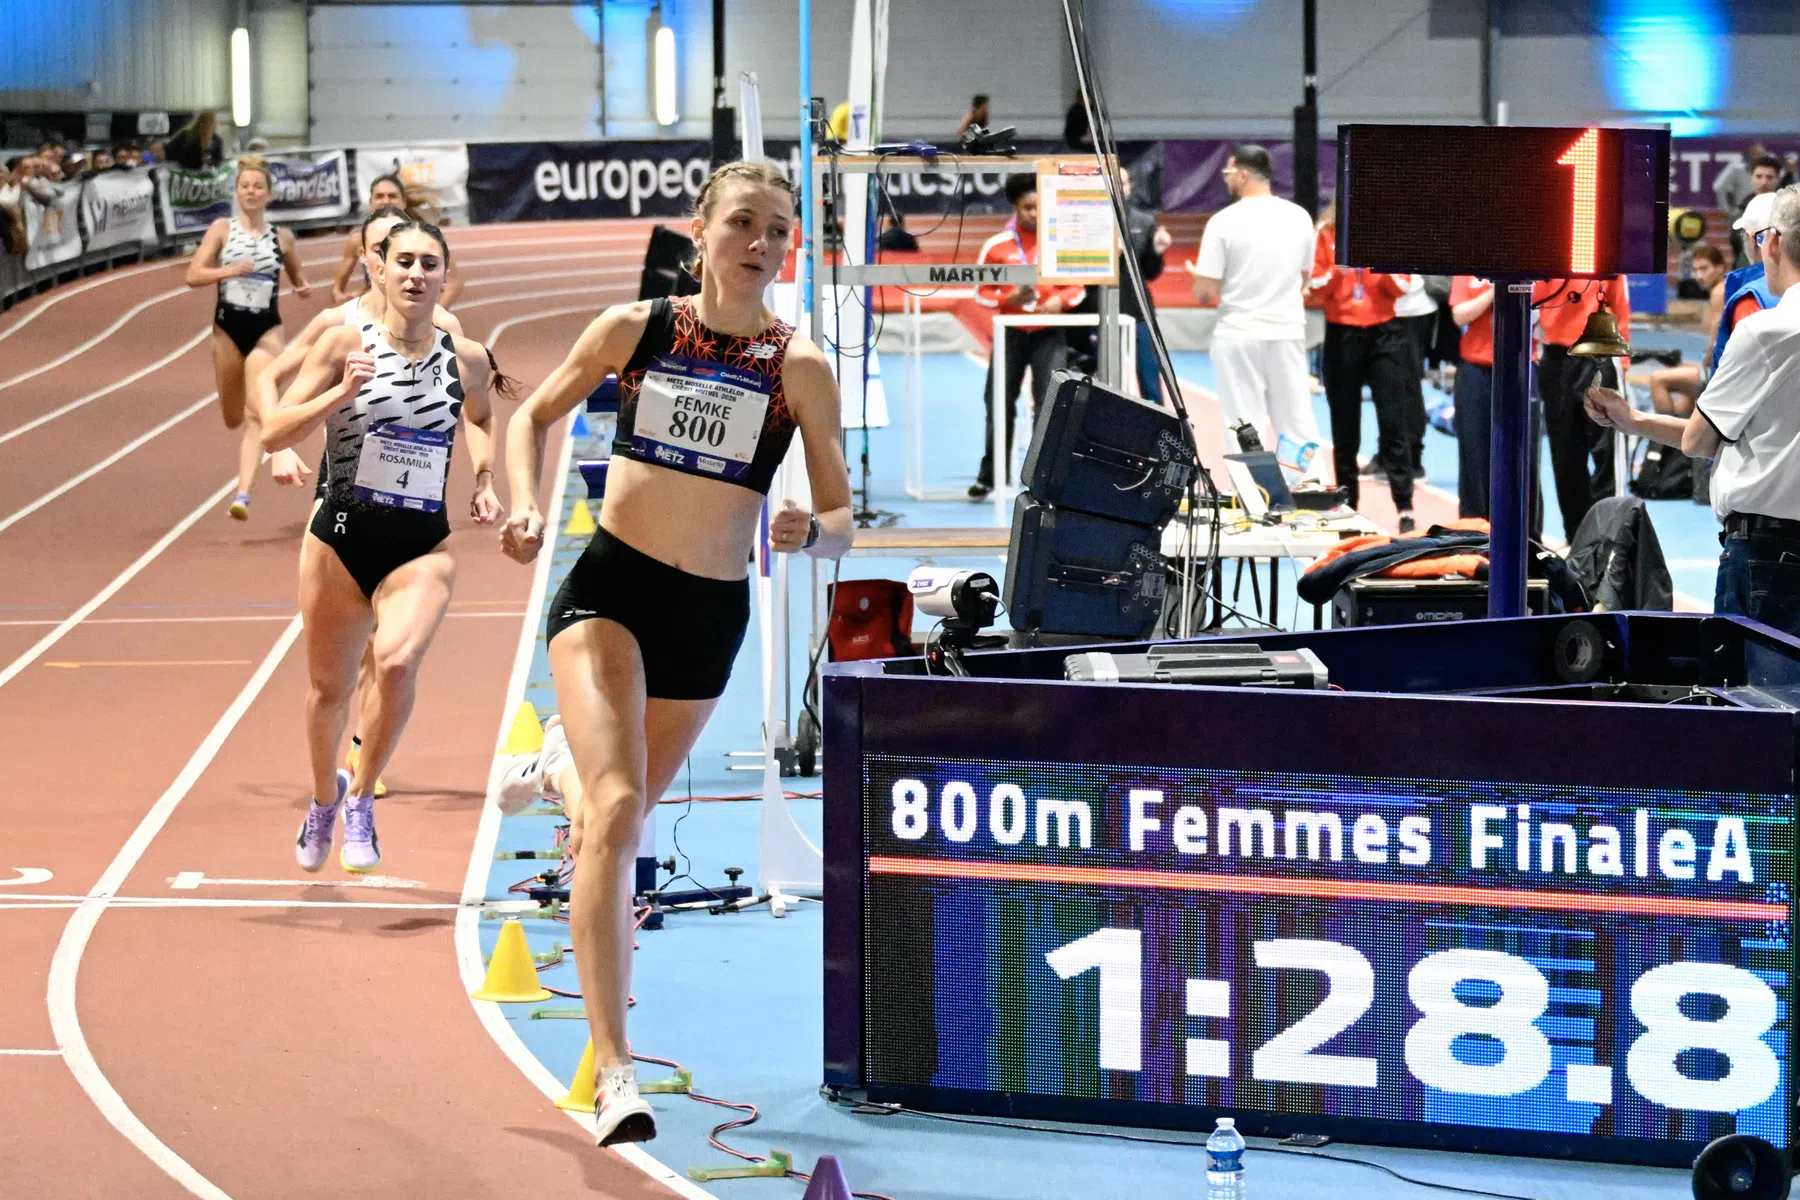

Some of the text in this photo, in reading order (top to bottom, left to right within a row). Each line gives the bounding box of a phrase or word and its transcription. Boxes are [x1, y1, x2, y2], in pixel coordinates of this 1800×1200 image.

[1556, 127, 1598, 274] 1
[929, 267, 1002, 282] MARTY
[674, 395, 732, 420] FEMKE
[669, 411, 726, 447] 800
[380, 453, 432, 469] ROSAMILIA
[396, 470, 409, 489] 4
[891, 778, 1092, 849] 800m
[1128, 789, 1431, 865] Femmes
[1045, 927, 1780, 1114] 1:28.8
